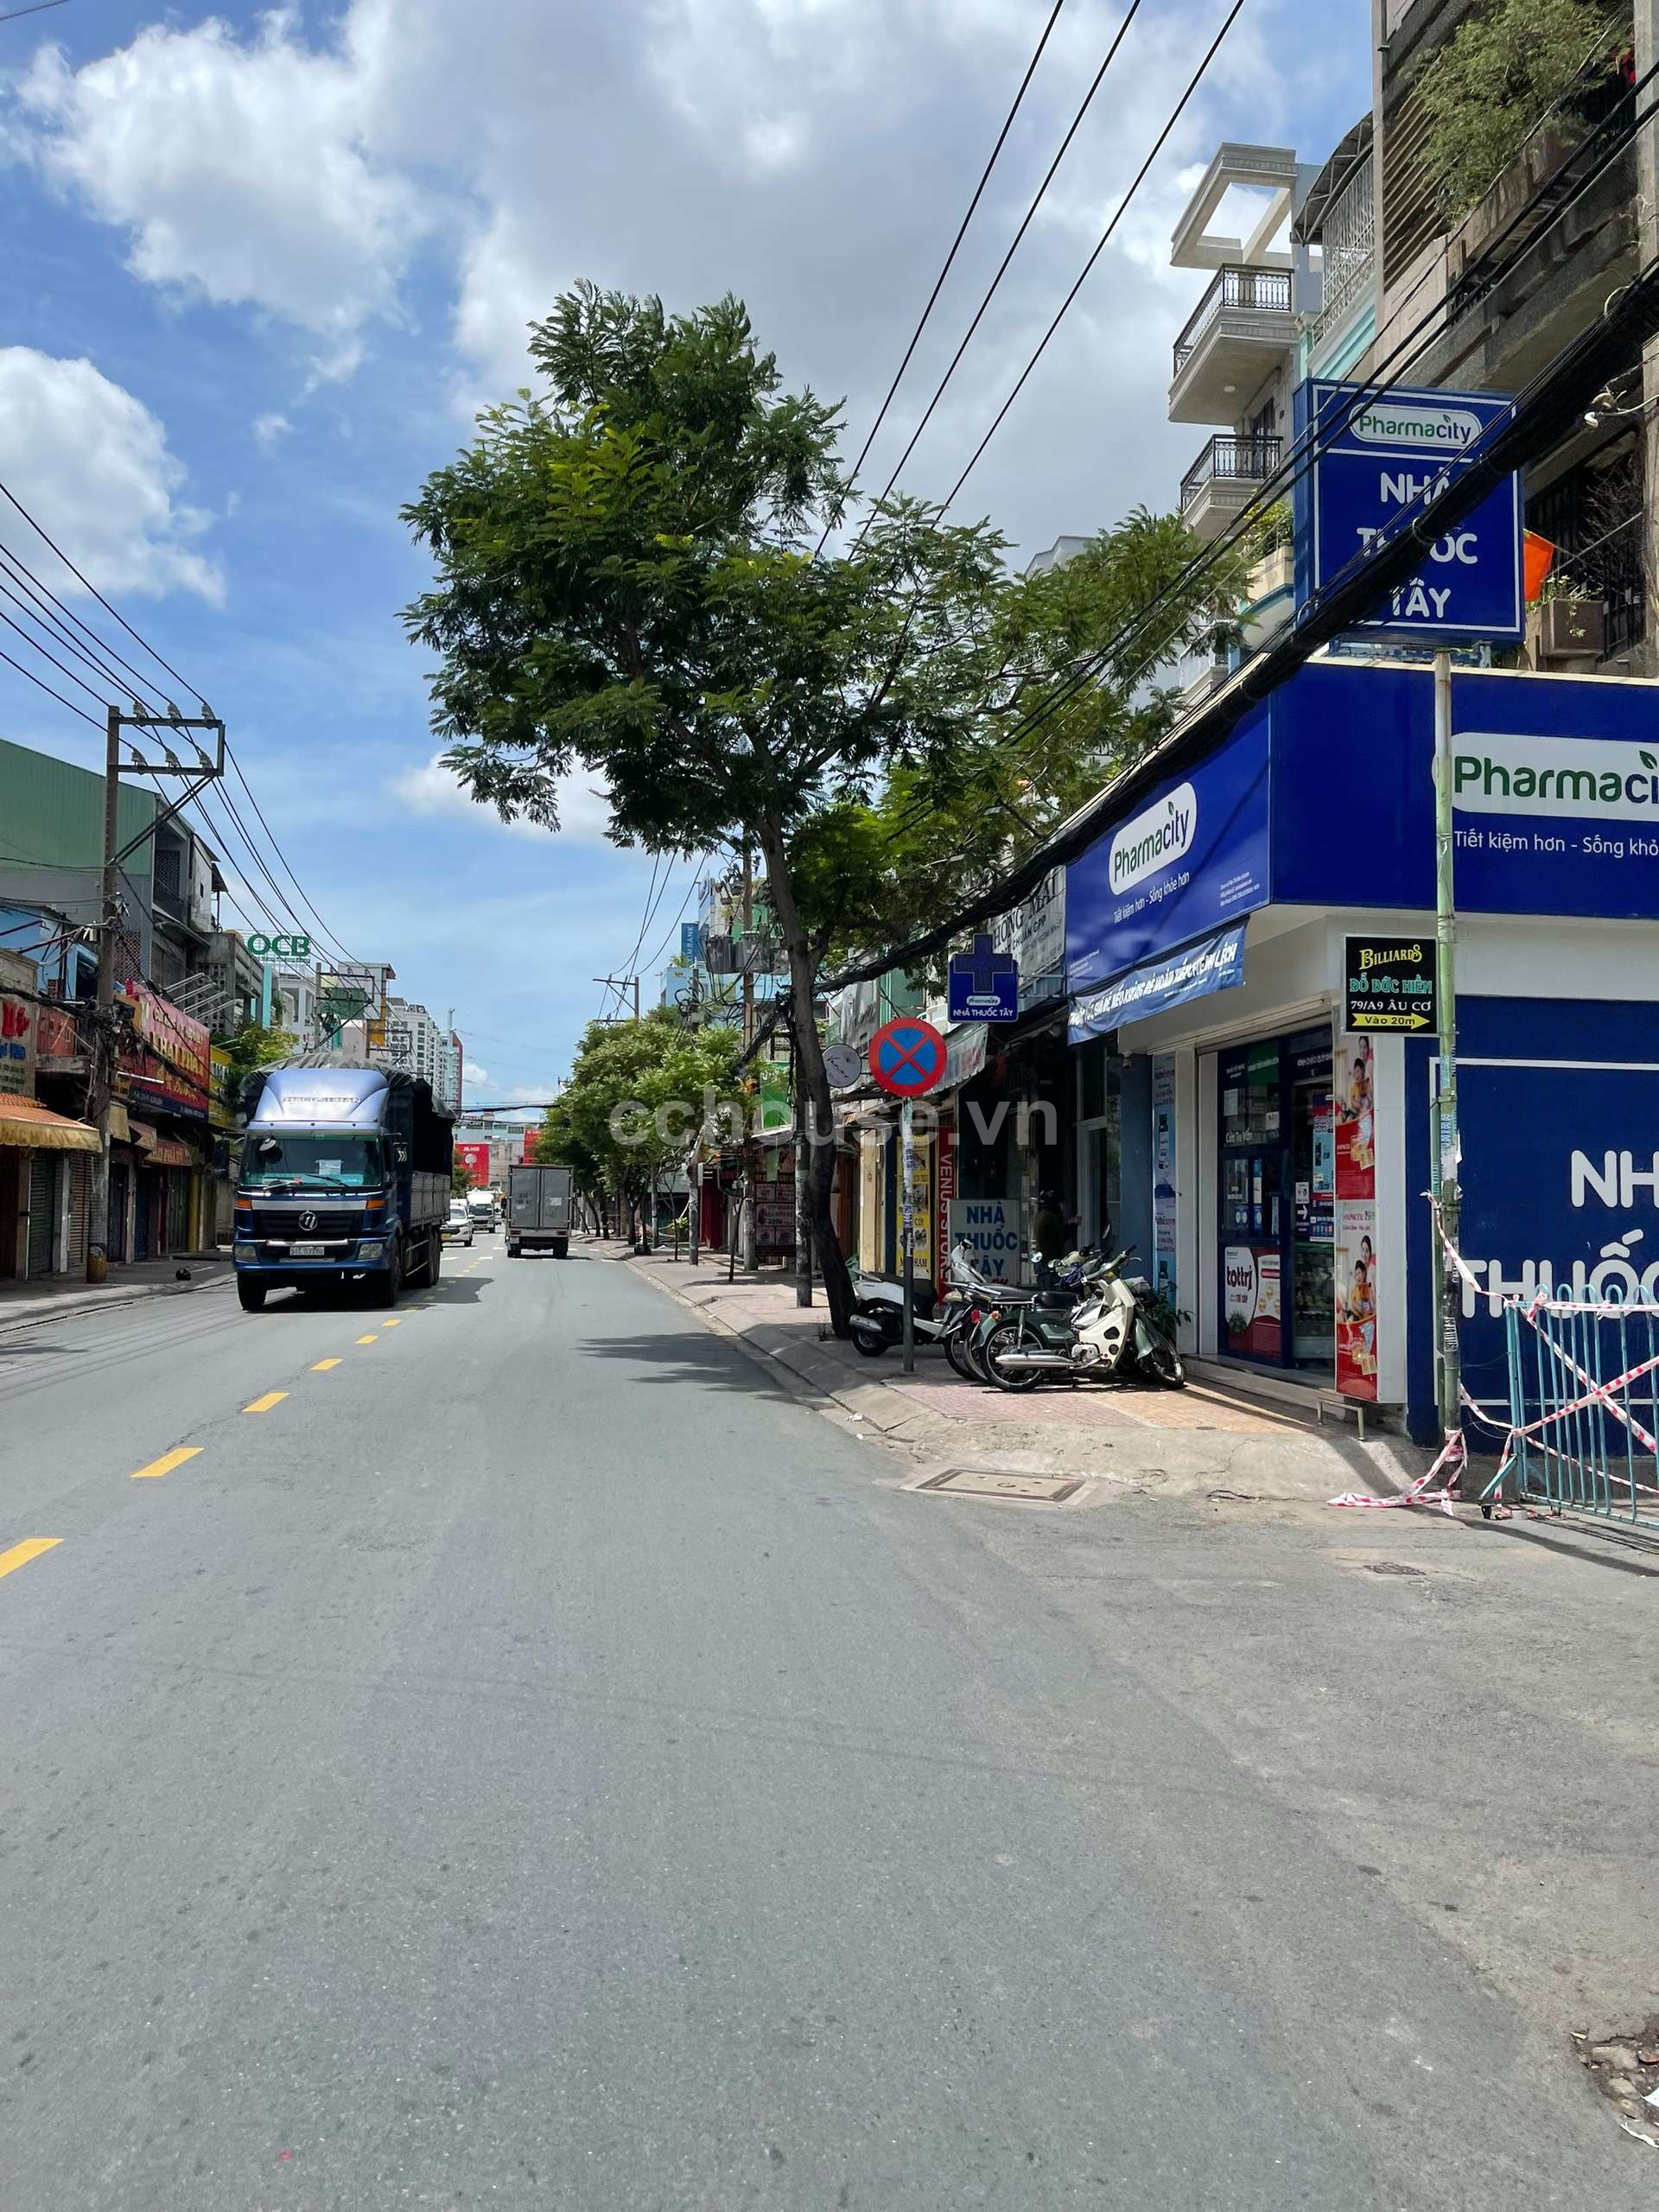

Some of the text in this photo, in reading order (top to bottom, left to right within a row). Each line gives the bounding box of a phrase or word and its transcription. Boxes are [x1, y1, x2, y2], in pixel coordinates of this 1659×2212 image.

[1359, 415, 1471, 444] Pharmacity
[1115, 802, 1190, 883] Pharmacity
[1454, 829, 1484, 849] Tiết
[1489, 831, 1529, 852] kiệm
[1534, 833, 1566, 852] hơn
[1583, 834, 1624, 859] Sống
[247, 934, 310, 957] OCB
[953, 1007, 1014, 1017] NHÀ THUỐC TÂY
[1351, 999, 1432, 1012] 79/A9 ÂU CƠ
[1364, 1015, 1415, 1025] Vào 20m
[966, 1201, 1006, 1224] NHÀ
[955, 1224, 1018, 1250] THUỐC
